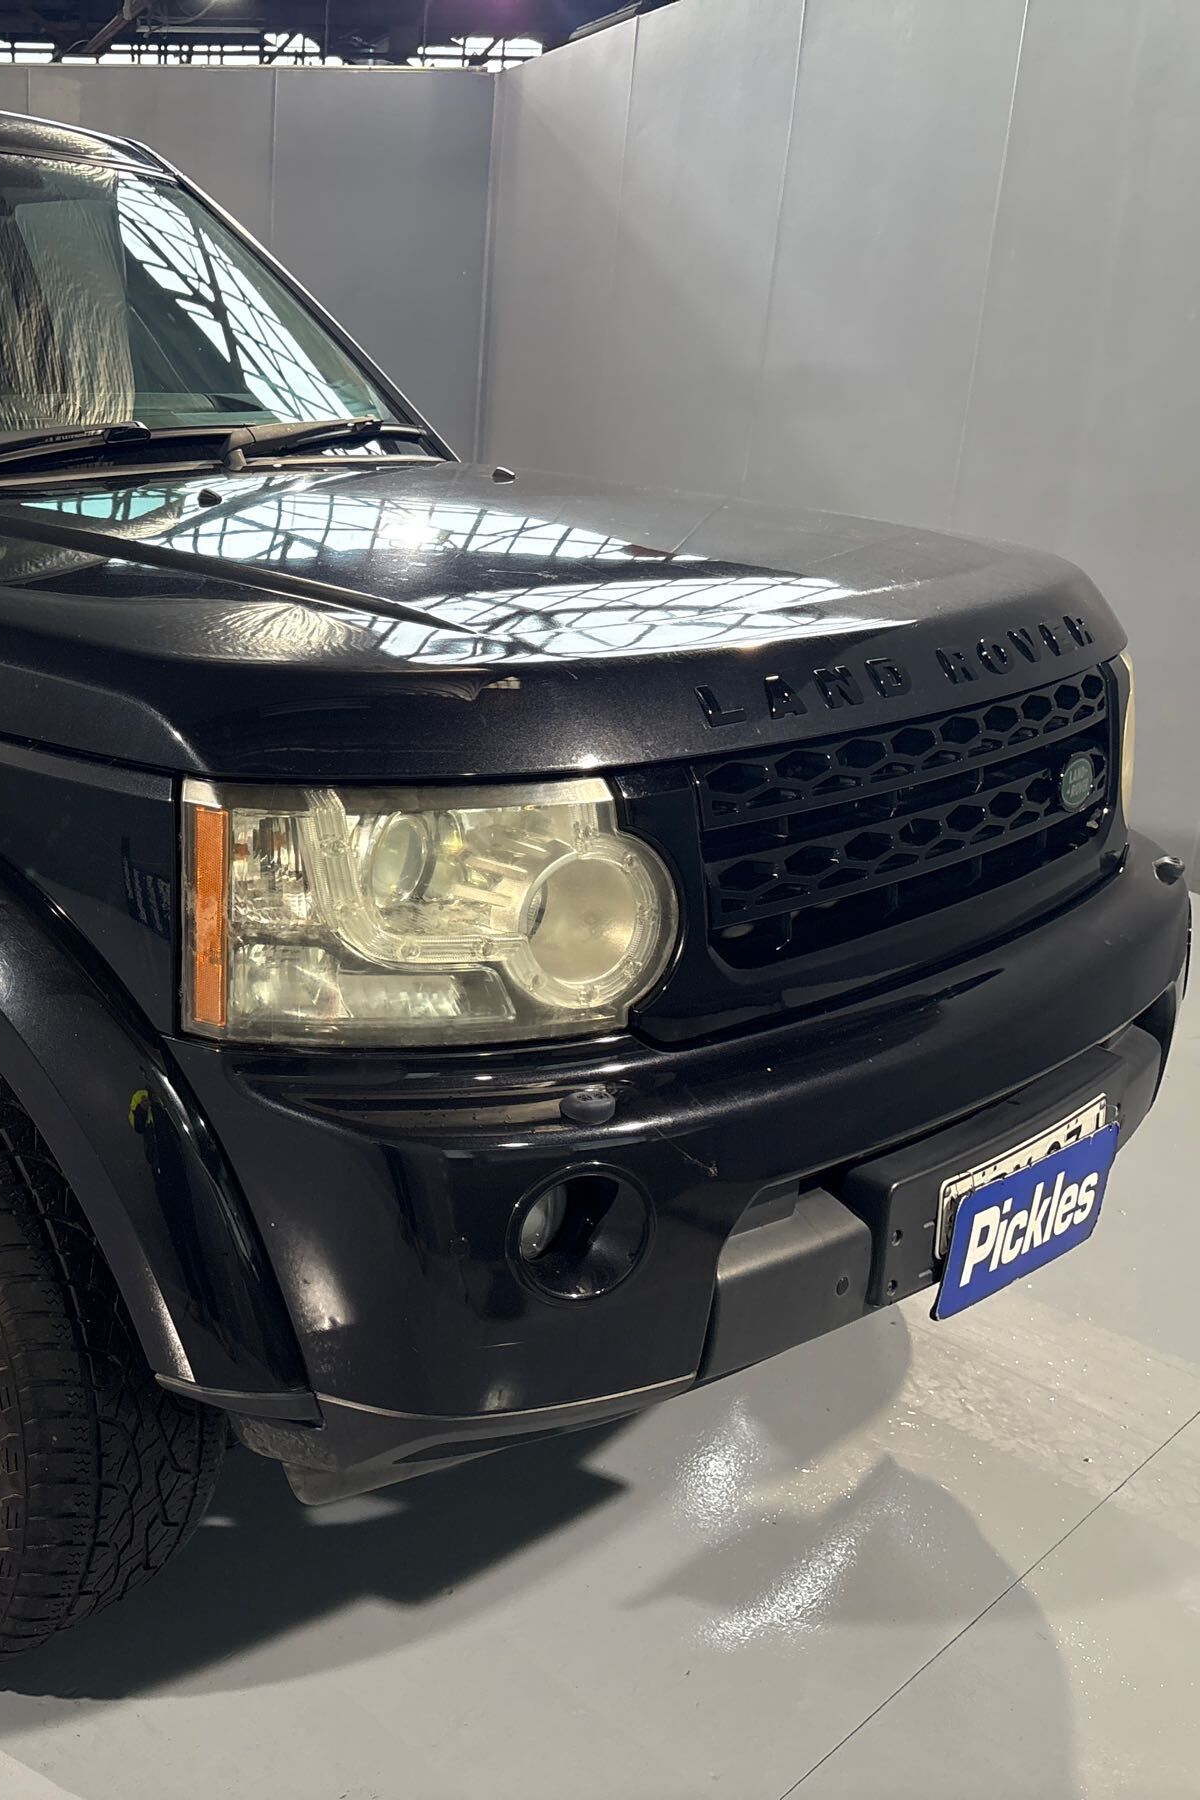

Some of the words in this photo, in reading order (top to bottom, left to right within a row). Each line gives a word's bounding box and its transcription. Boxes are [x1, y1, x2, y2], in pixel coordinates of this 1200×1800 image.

[694, 656, 913, 728] LAND
[934, 614, 1097, 685] ROVER
[959, 1170, 1100, 1288] Pickles
